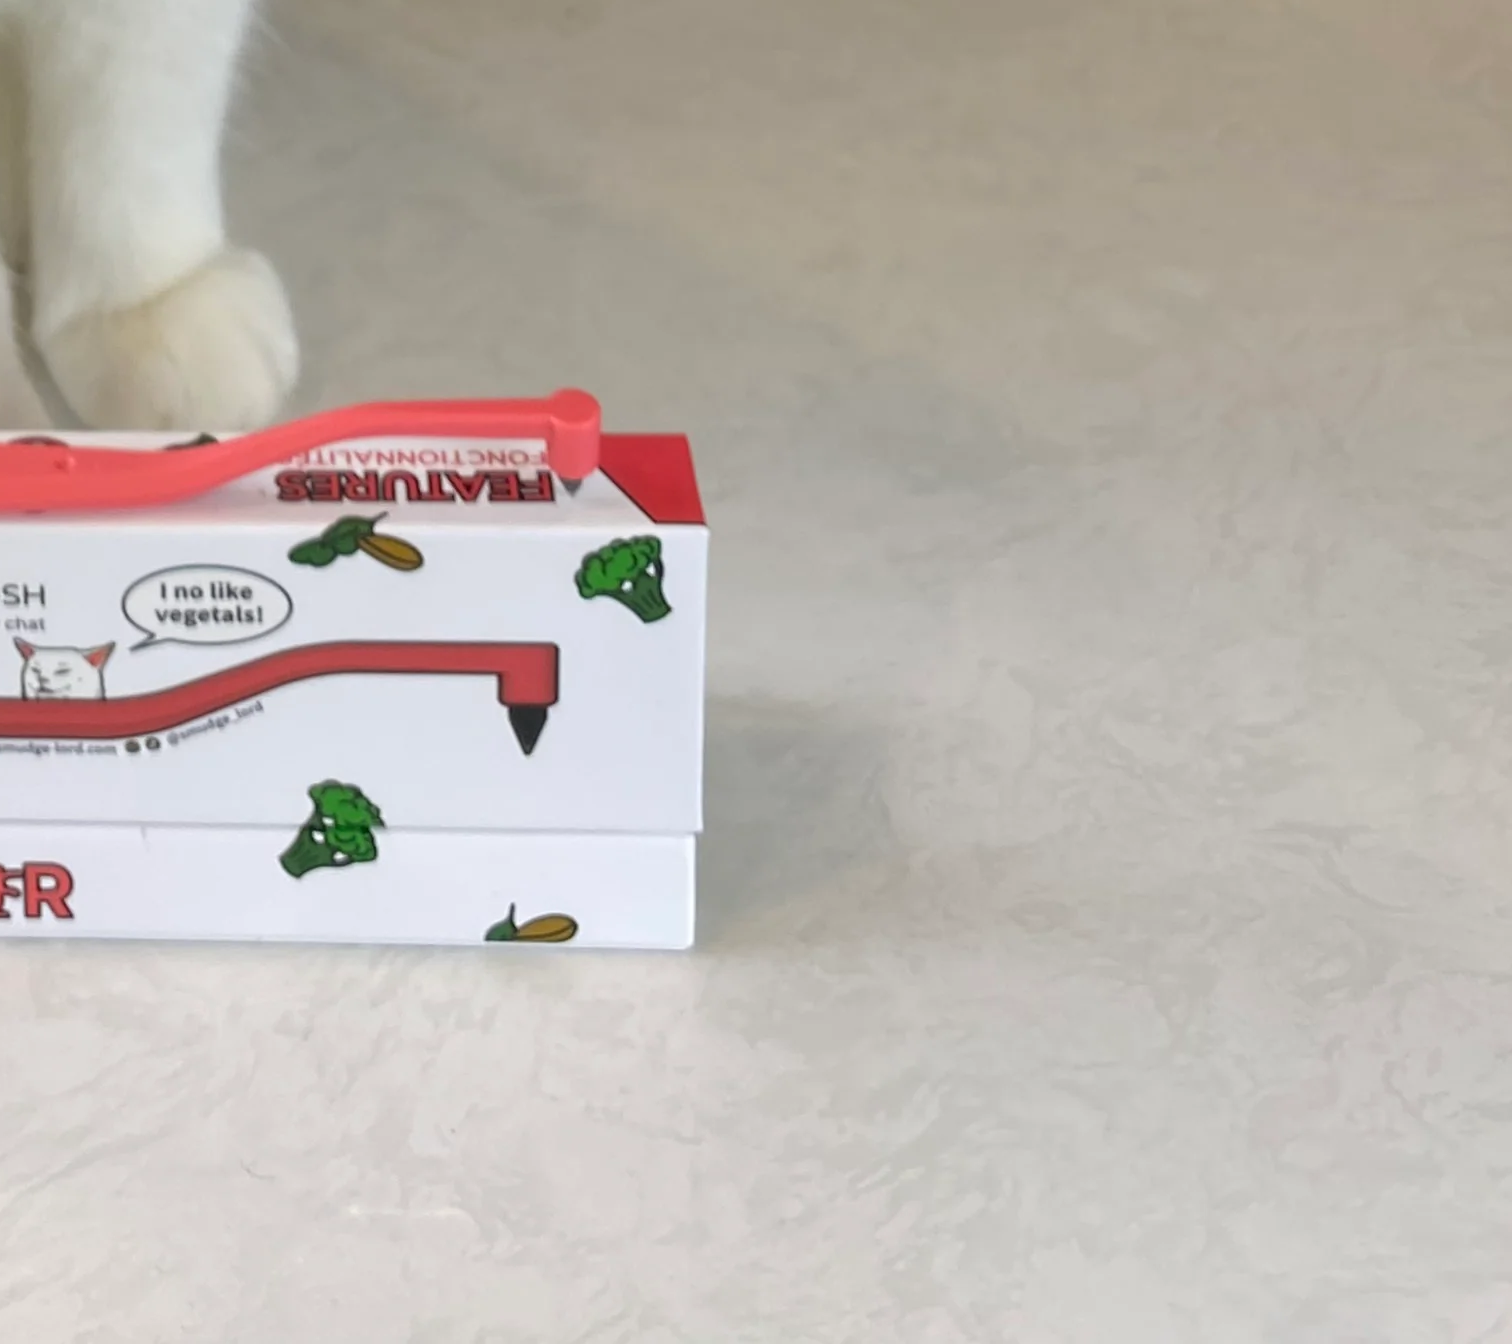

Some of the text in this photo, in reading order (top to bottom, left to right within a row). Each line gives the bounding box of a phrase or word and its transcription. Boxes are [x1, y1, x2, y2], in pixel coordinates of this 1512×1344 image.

[275, 468, 556, 503] FEATURES
[160, 580, 253, 600] I no like
[4, 616, 46, 632] chat
[155, 605, 264, 626] vegetals!
